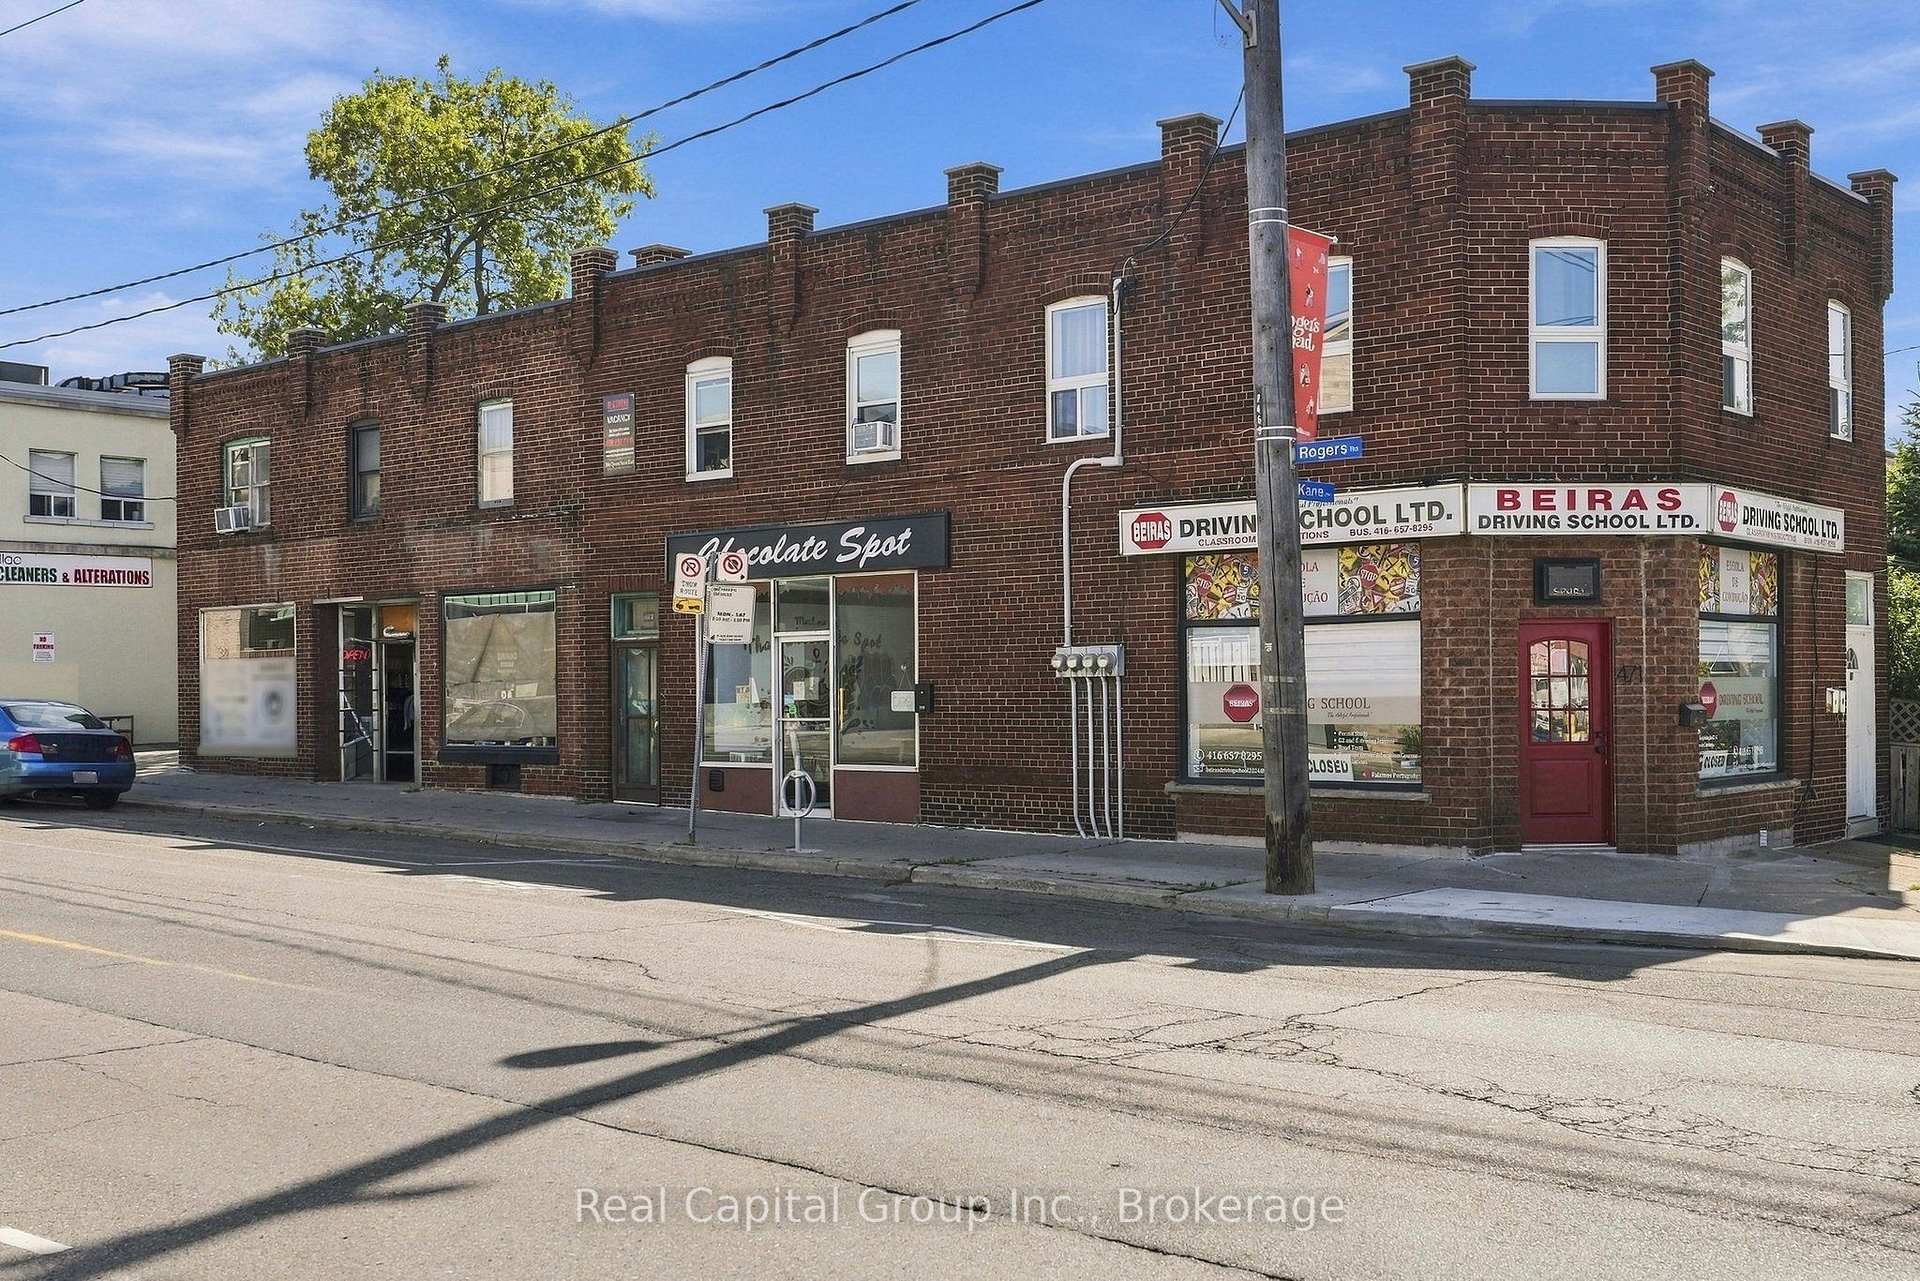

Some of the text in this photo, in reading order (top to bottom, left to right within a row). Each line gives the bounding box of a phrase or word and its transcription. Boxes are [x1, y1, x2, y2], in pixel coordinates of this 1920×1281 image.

[1299, 444, 1347, 459] Rogers
[1298, 483, 1324, 497] Kane
[1497, 488, 1682, 511] BEIRAS
[1180, 500, 1453, 538] DRIVIN CHOOL LTD.
[1478, 514, 1700, 529] DRIVING SCHOOL LTD.
[1743, 505, 1781, 531] DRIVING
[1784, 513, 1819, 537] SCHOOL
[1821, 519, 1840, 540] LTD.
[1133, 520, 1171, 541] BEIRAS
[1198, 535, 1257, 547] CLASSROOM
[1350, 529, 1372, 537] BUS.
[836, 526, 912, 568] Spot
[0, 566, 150, 585] CLEANERS & ALTERATIONS
[1361, 569, 1378, 581] STOP
[344, 650, 369, 661] OPEN
[1321, 698, 1371, 709] SCHOOL
[1308, 760, 1349, 774] CLOSED
[1703, 755, 1725, 769] CLOSED
